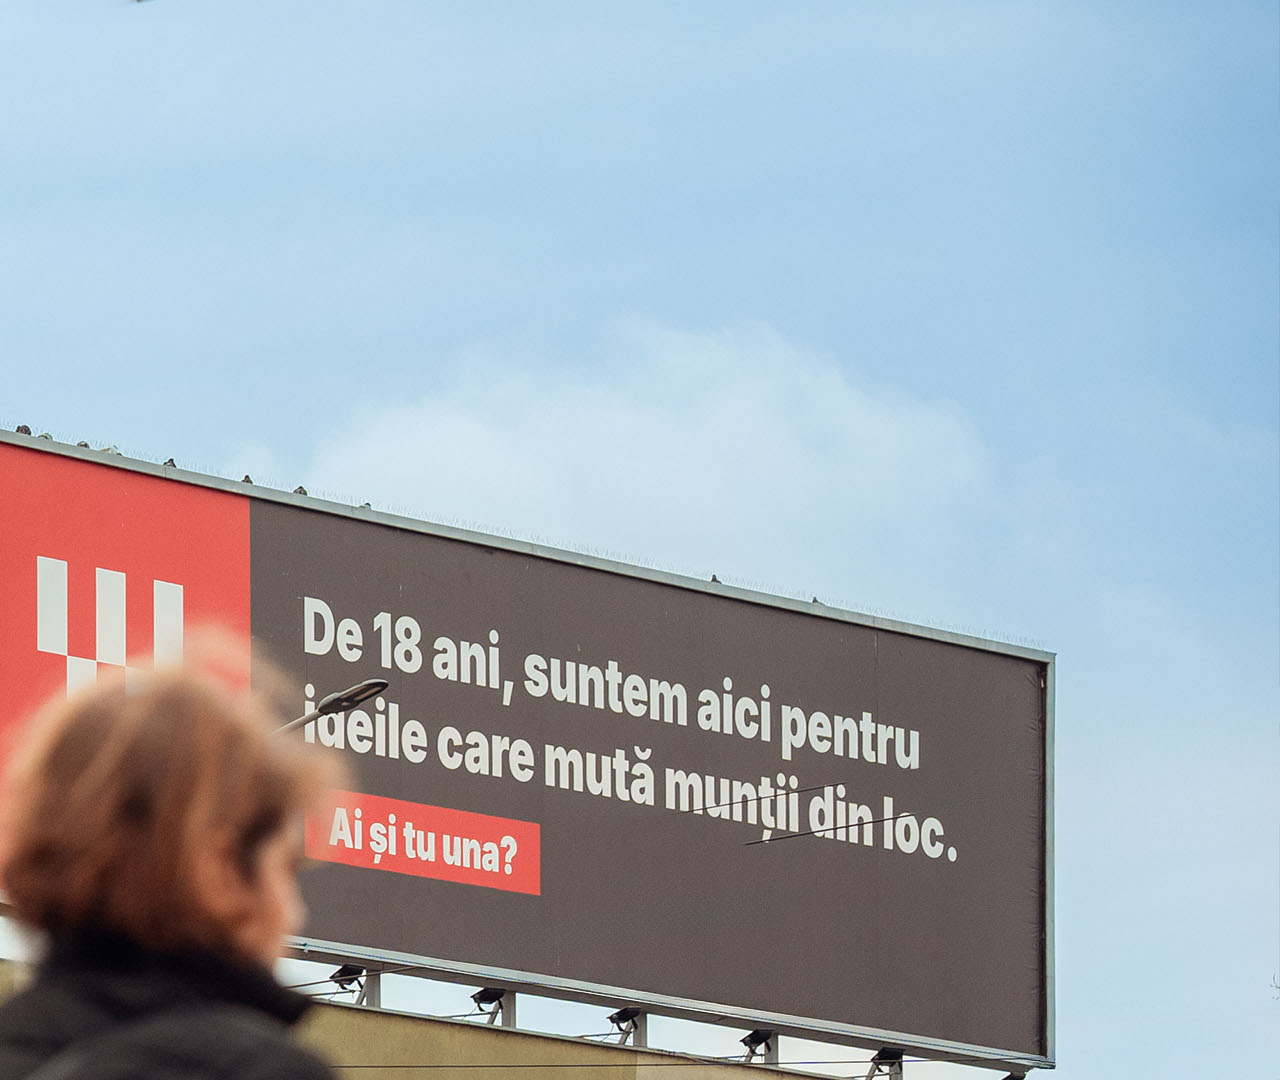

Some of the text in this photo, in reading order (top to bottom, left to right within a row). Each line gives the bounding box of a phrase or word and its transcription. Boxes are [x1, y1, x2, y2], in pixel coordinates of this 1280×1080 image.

[303, 597, 920, 770] De 18 ani, suntem aici pentru
[329, 807, 518, 875] Ai și tu una?
[438, 724, 535, 784] care
[544, 745, 655, 807] mută
[664, 764, 799, 844] munții
[808, 785, 874, 848] din
[882, 796, 958, 862] loc.
